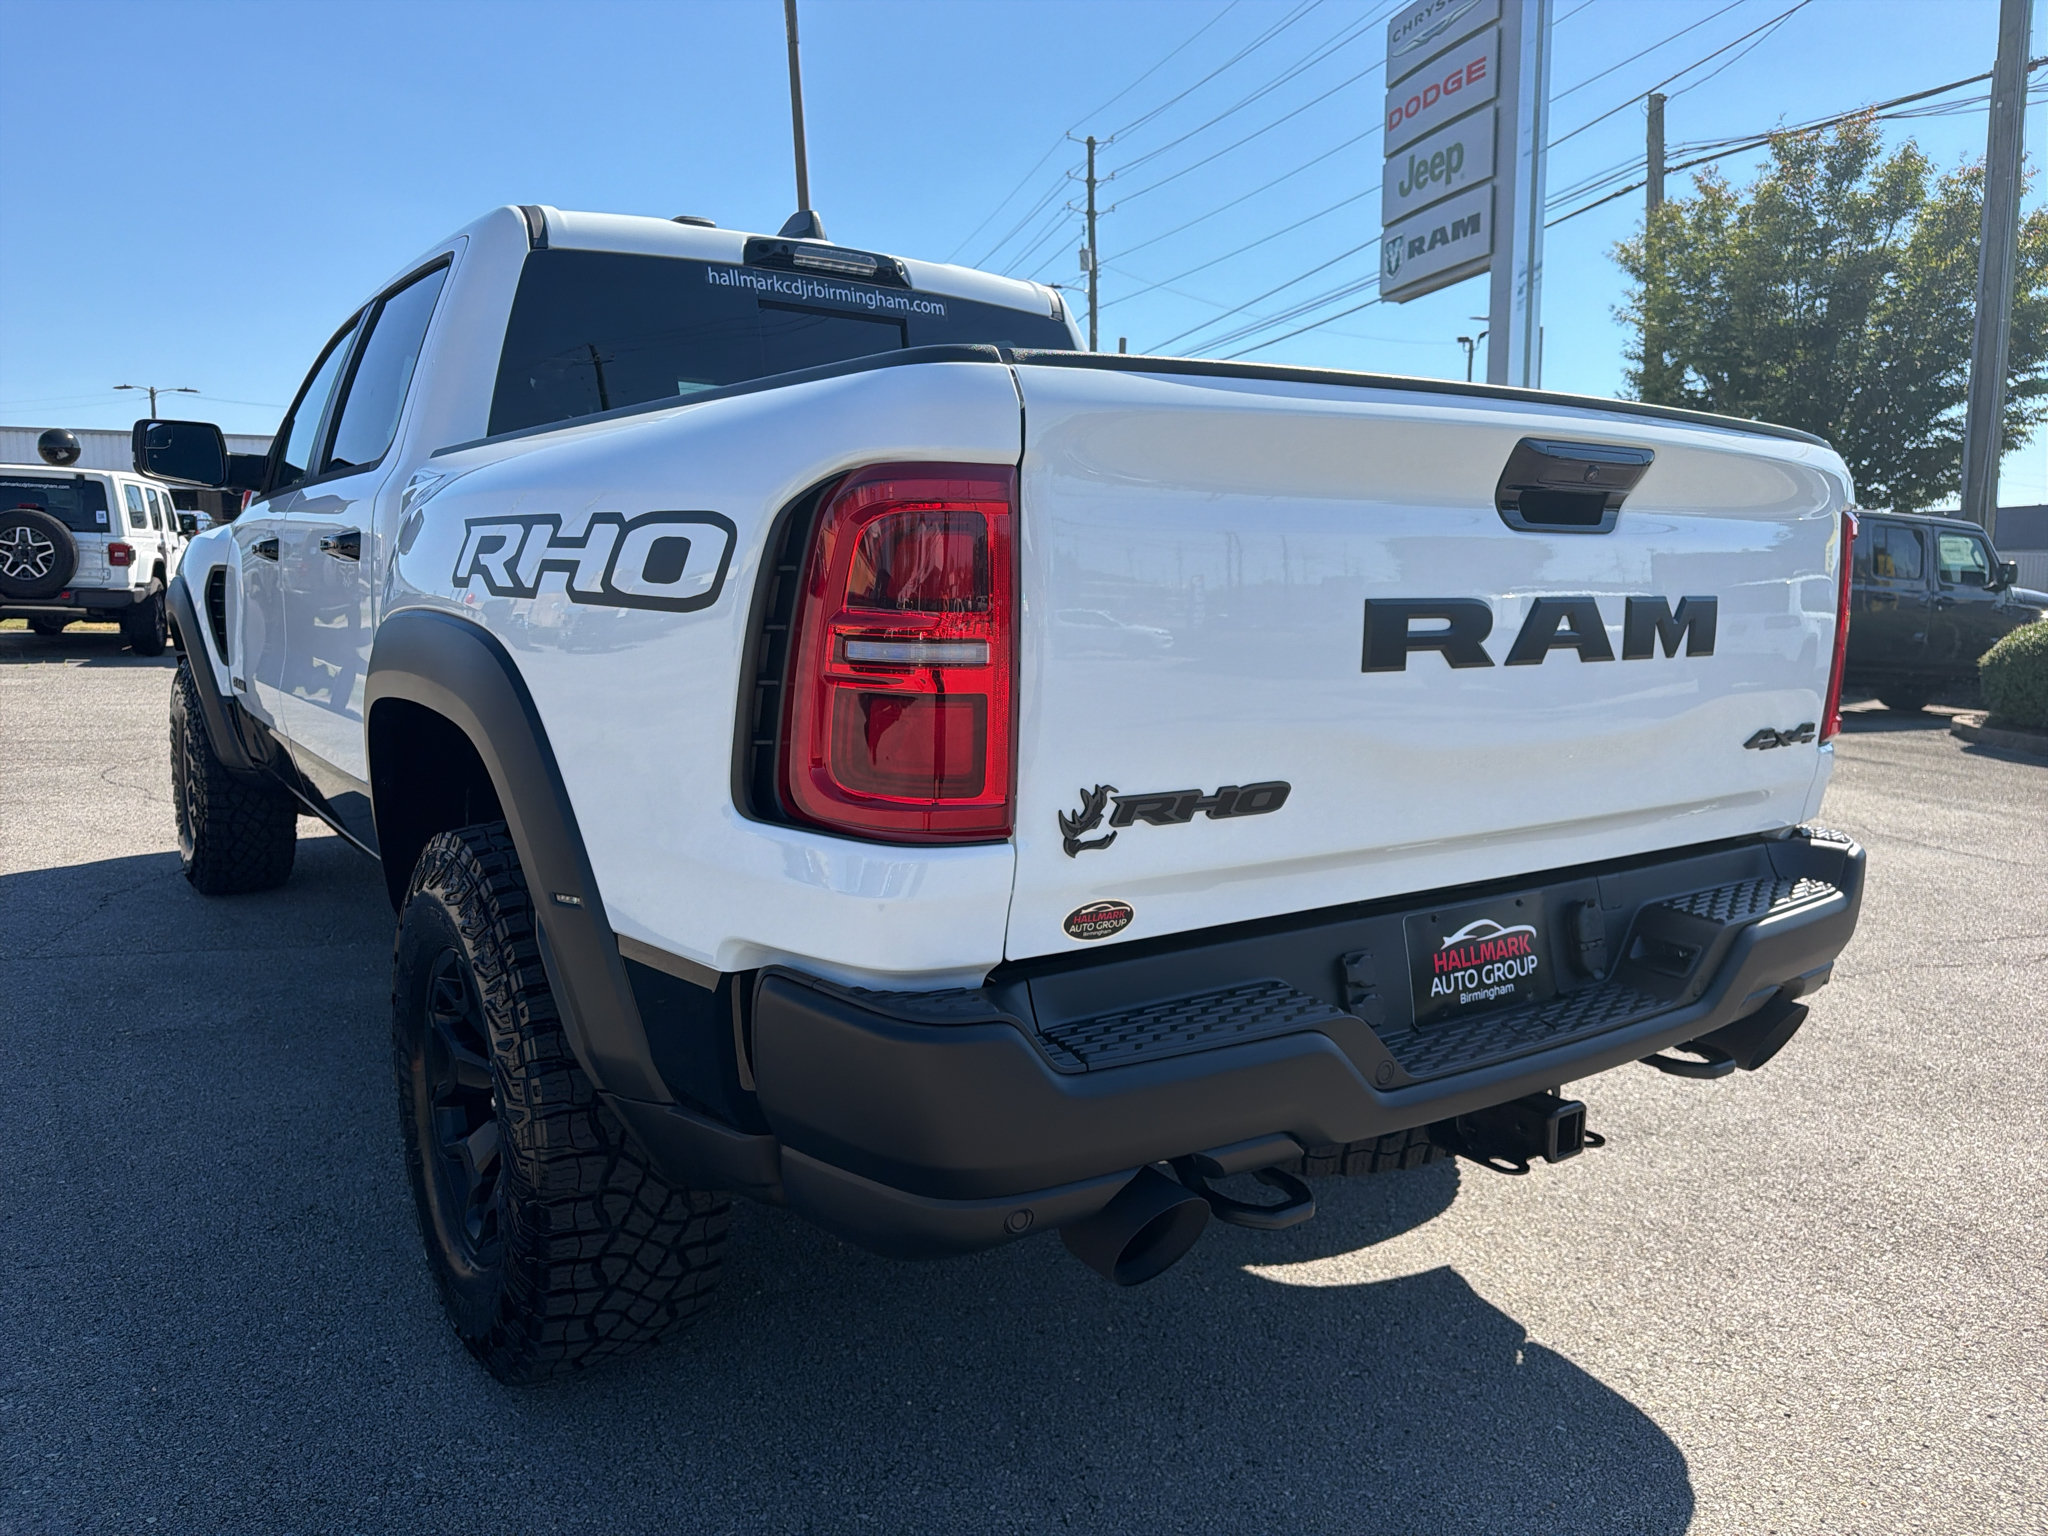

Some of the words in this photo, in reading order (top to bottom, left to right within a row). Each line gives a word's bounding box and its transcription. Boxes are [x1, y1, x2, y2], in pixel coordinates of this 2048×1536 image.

[1393, 0, 1452, 42] CHRYS
[1388, 56, 1487, 132] DODGE
[1398, 142, 1465, 198] Jeep
[1407, 212, 1482, 260] RAM
[707, 266, 946, 316] hallmarkcdjrbirmingham.com
[453, 510, 738, 613] RHO
[1361, 595, 1719, 673] RAM
[1108, 780, 1292, 828] RHO
[1068, 922, 1095, 934] AUTO
[1096, 918, 1128, 930] GROUP
[1073, 910, 1126, 924] HALLMARK
[1430, 968, 1478, 998] AUTO
[1482, 955, 1538, 985] GROUP
[1433, 933, 1532, 974] HALLMARK
[1460, 983, 1515, 1004] Birmingham
